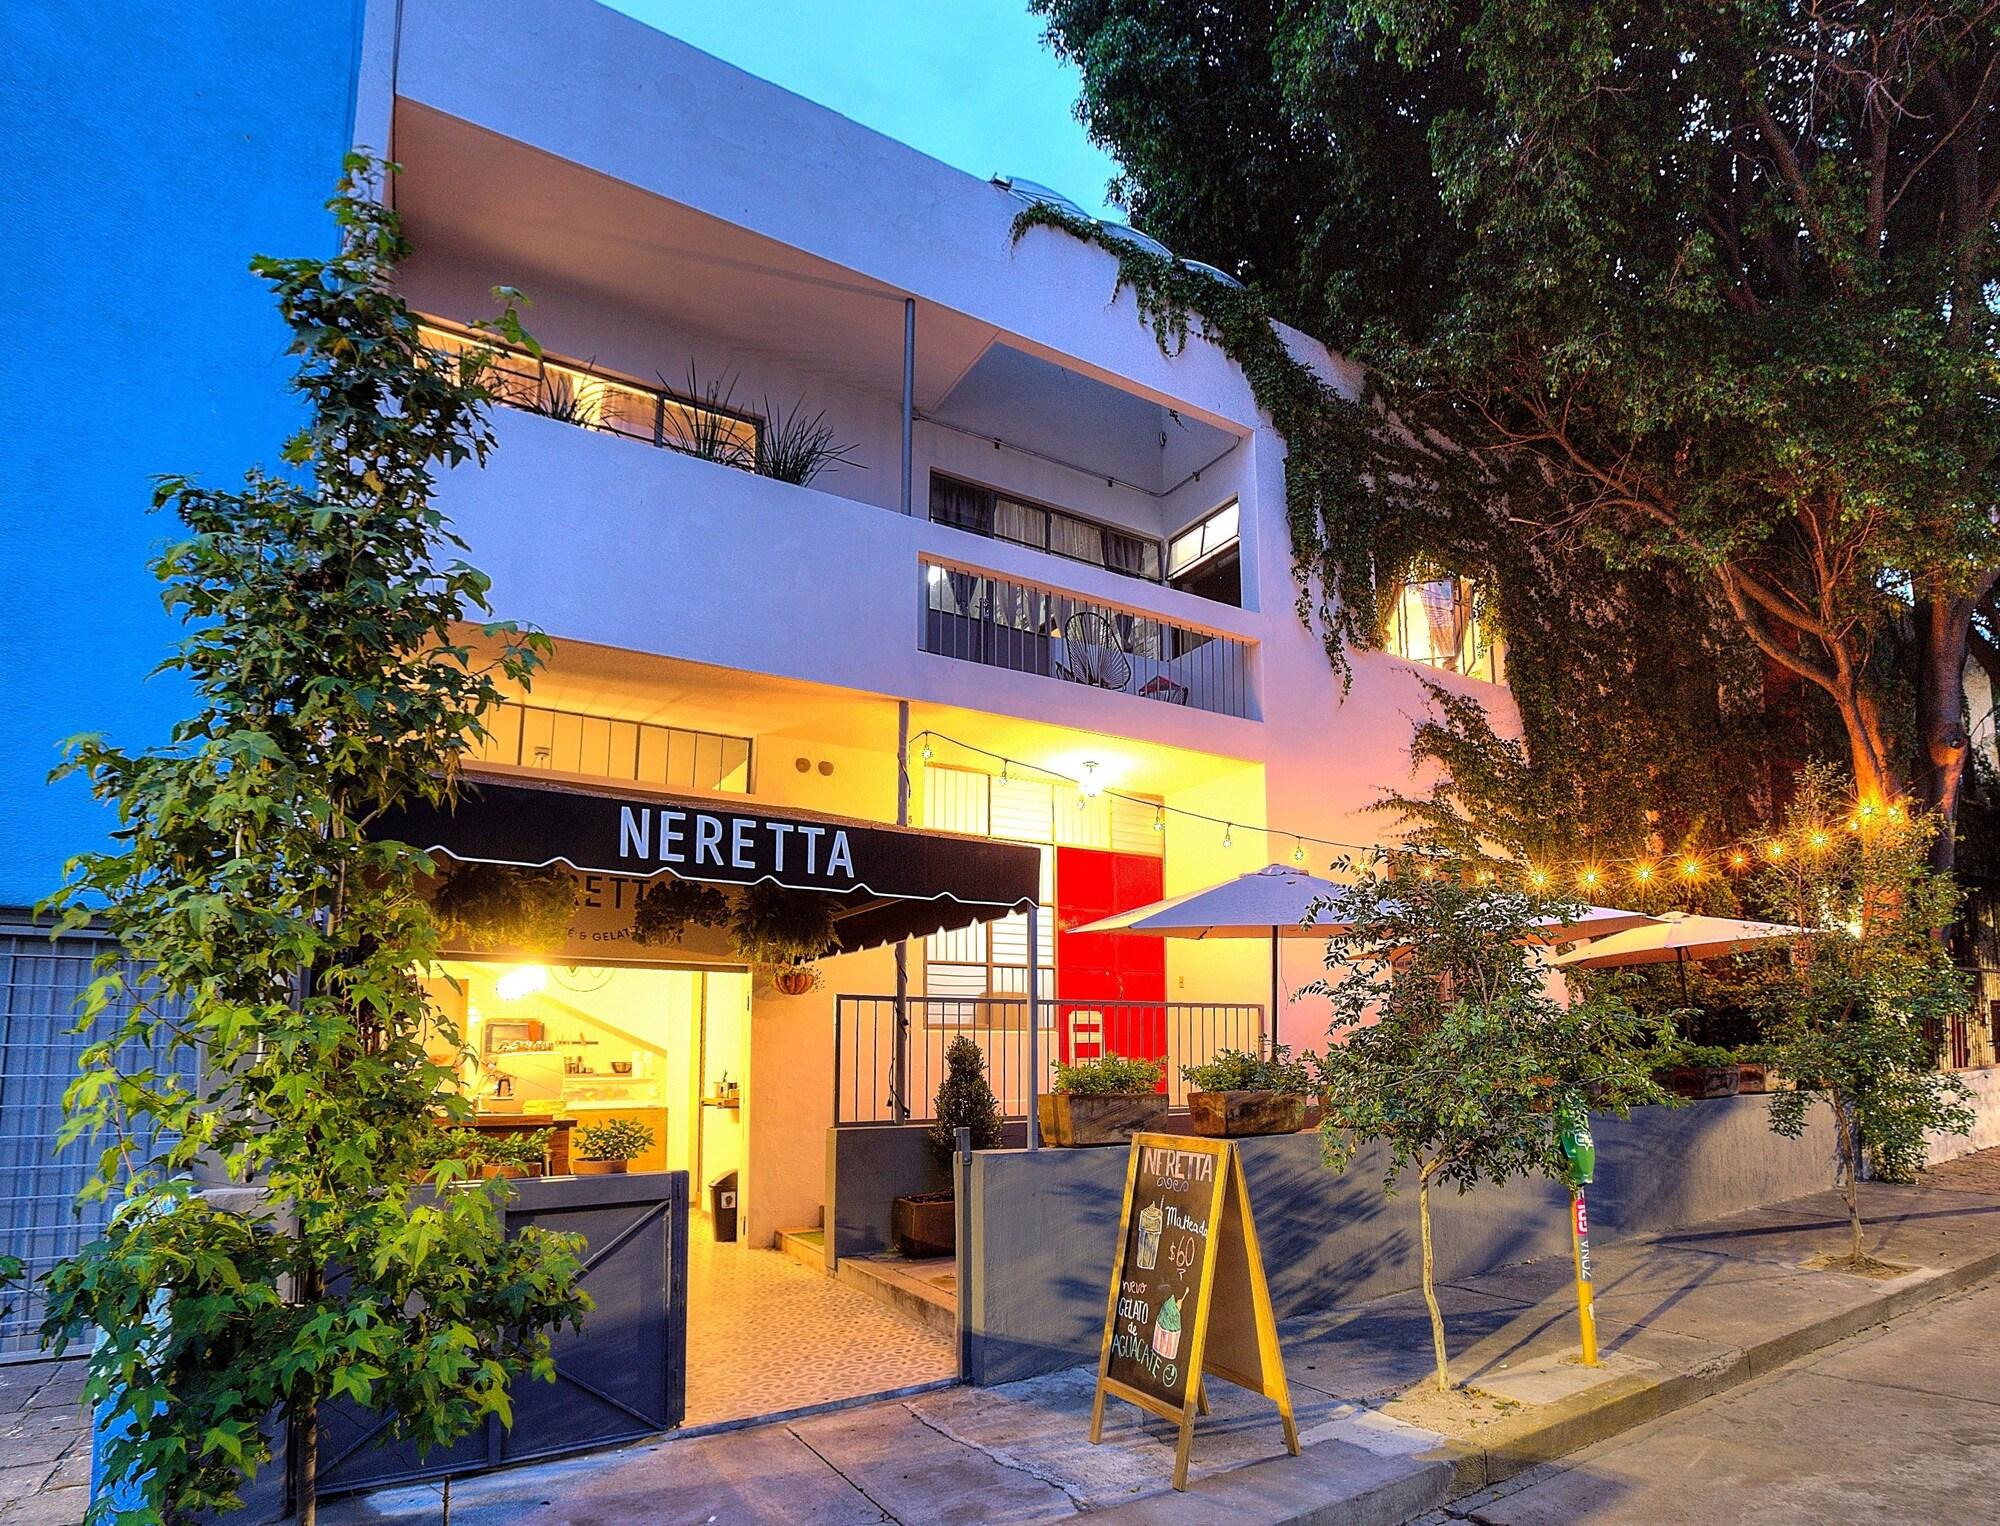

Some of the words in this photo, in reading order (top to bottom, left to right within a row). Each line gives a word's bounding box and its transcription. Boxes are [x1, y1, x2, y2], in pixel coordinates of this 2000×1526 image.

[619, 806, 855, 878] NERETTA
[592, 926, 640, 942] GELAT
[1143, 1147, 1213, 1183] NERETTA
[1168, 1235, 1196, 1268] $60
[1580, 1239, 1592, 1280] ZONA
[1118, 1297, 1149, 1325] GELATO
[1127, 1321, 1138, 1337] de
[1111, 1332, 1163, 1379] AGUACATE
